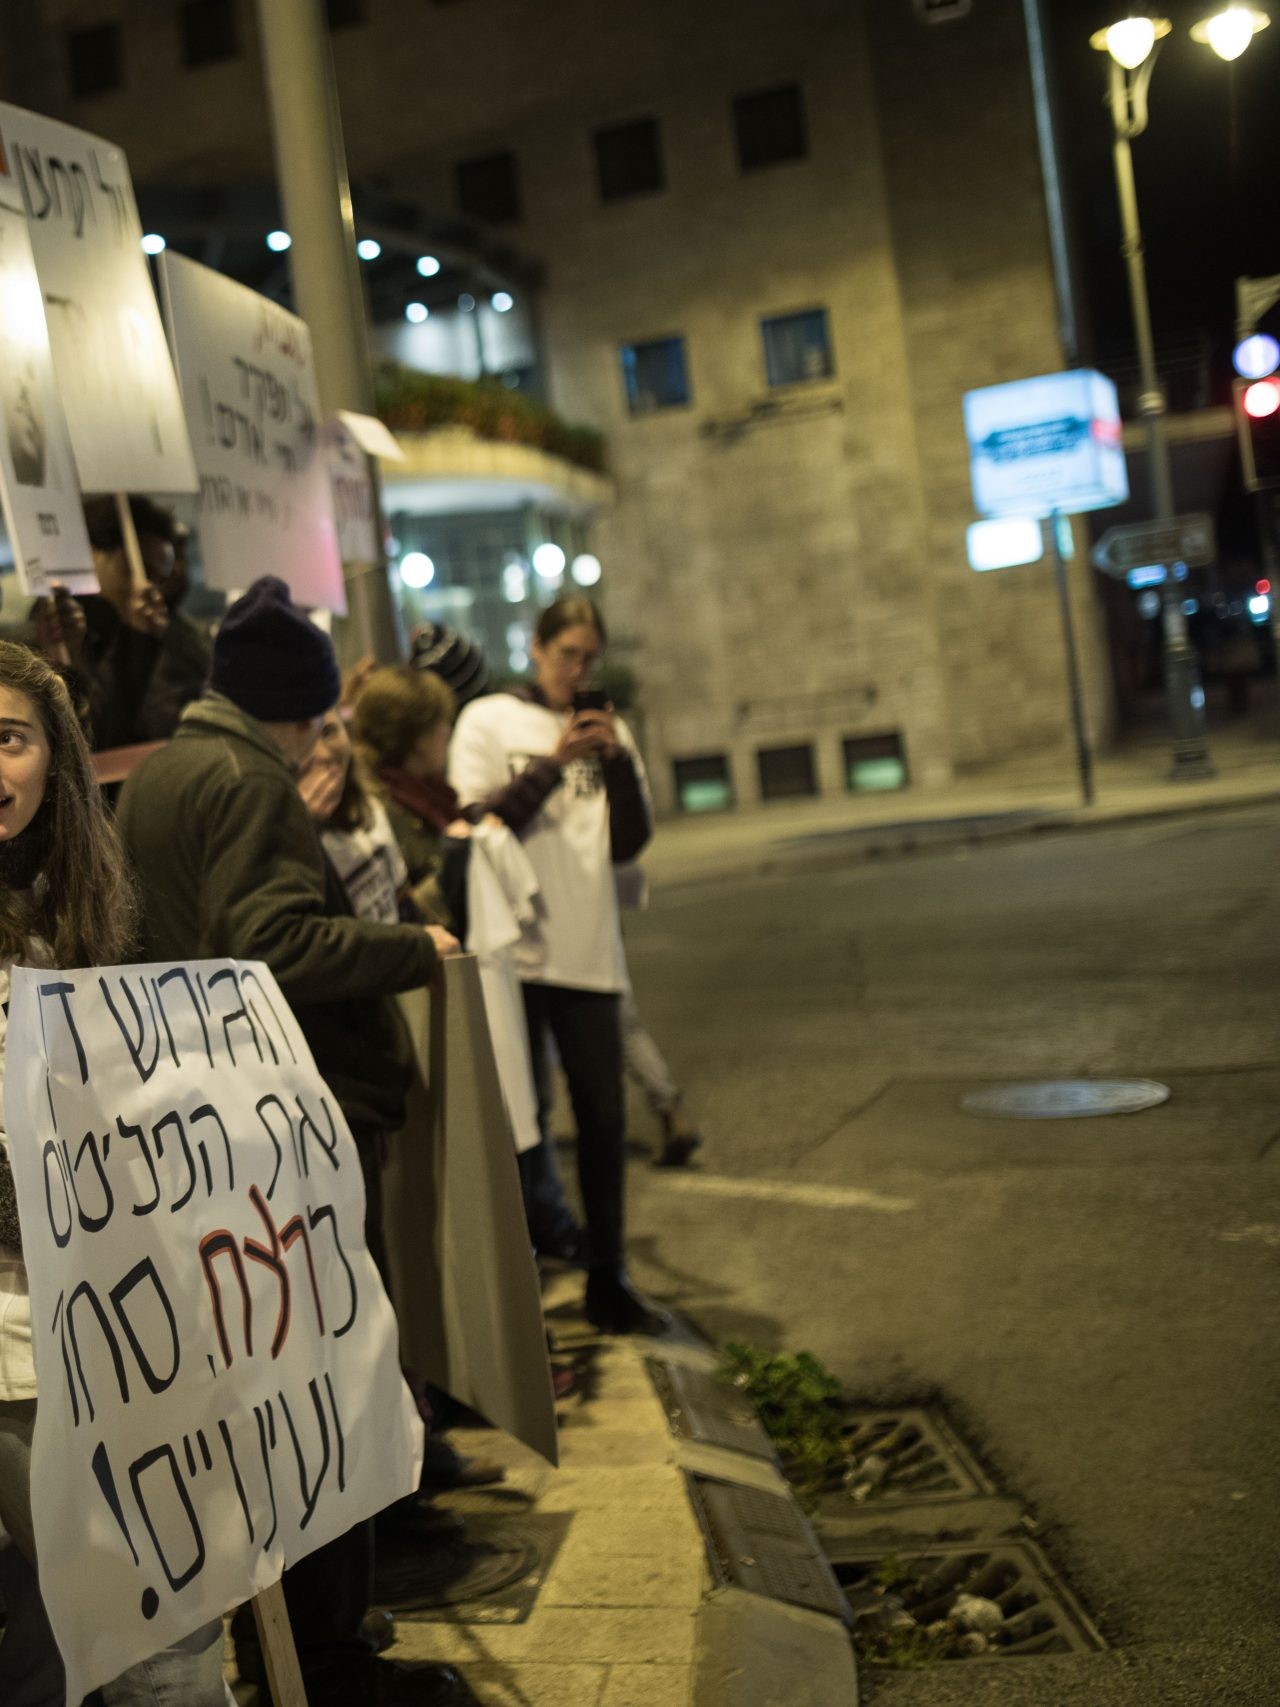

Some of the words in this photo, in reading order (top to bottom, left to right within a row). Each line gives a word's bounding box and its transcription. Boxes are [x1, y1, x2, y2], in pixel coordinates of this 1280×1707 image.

[99, 967, 297, 1084] הגירוש
[42, 1102, 235, 1249] הפליטים
[255, 1093, 341, 1202] את
